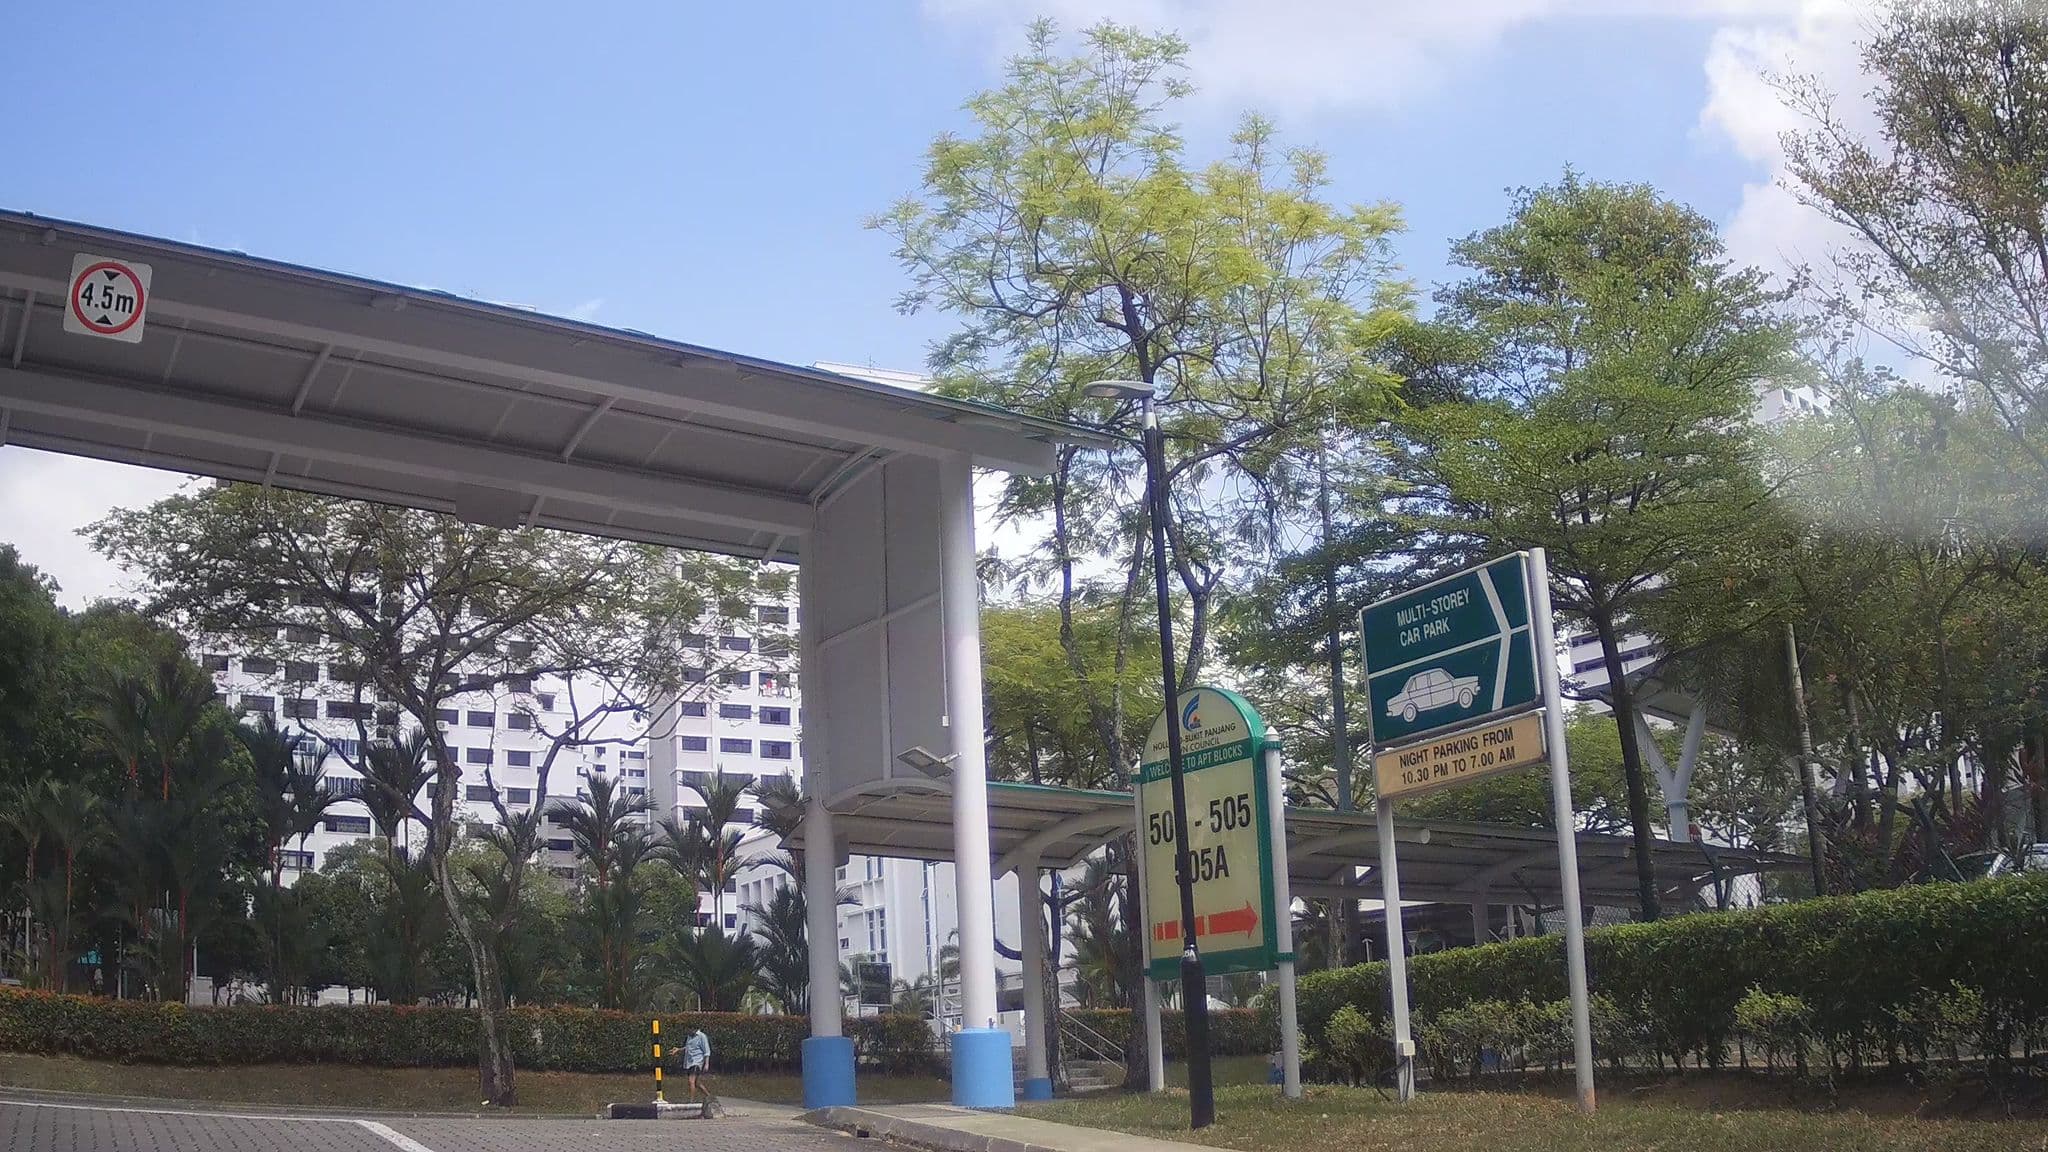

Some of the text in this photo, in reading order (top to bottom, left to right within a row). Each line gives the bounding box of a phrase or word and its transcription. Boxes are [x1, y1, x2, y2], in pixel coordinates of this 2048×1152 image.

[81, 282, 134, 314] 4.5m
[1396, 587, 1470, 627] MULTI-STOREY
[1399, 616, 1451, 647] CAR PARK
[1152, 731, 1202, 752] HOLL-BUKIT
[1204, 722, 1236, 738] PANJANG
[1190, 737, 1220, 752] COUNCIL
[1399, 726, 1514, 769] NIGHT PARKING FROM
[1149, 744, 1243, 778] WELC TO APT BLOCKS
[1402, 745, 1516, 785] 10.30 PM TO 7.00 AM
[1149, 810, 1175, 845] 50
[1210, 793, 1251, 833] 505
